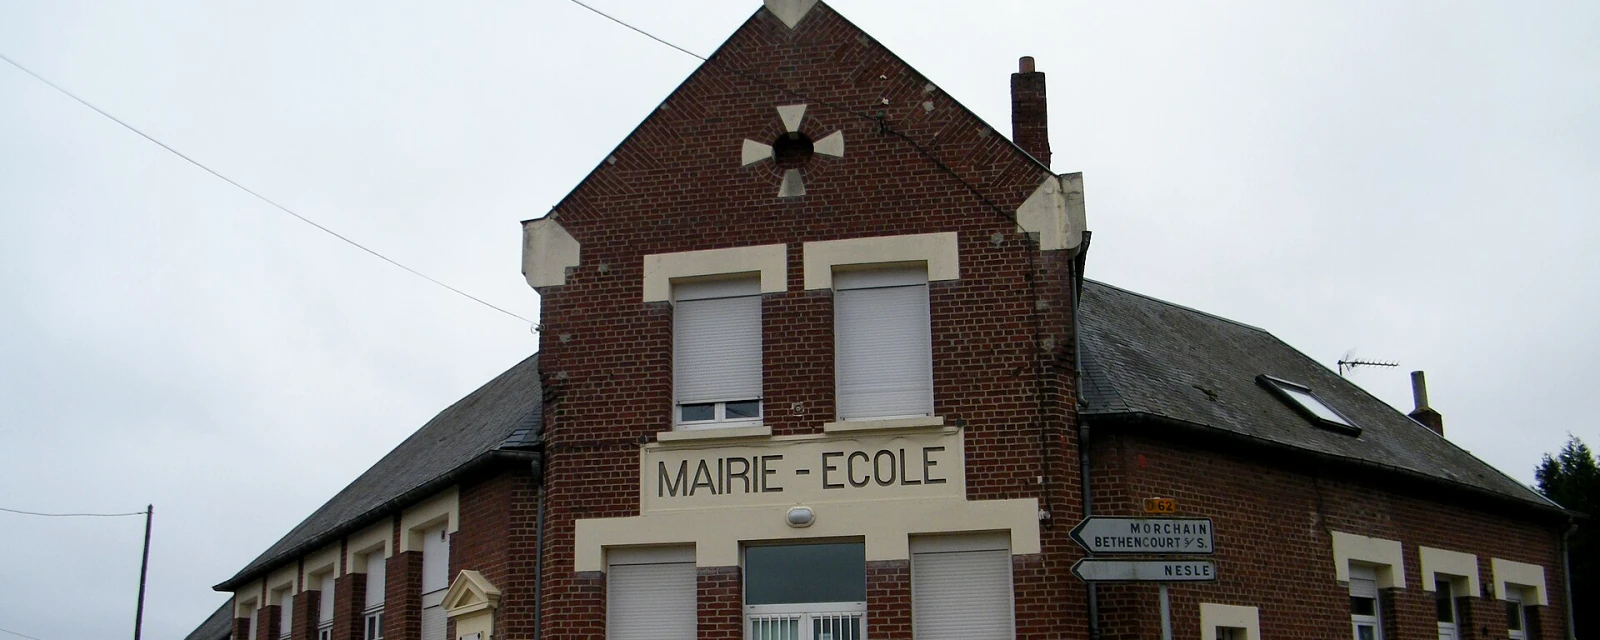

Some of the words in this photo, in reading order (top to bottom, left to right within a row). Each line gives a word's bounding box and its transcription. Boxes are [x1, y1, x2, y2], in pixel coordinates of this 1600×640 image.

[658, 454, 784, 498] MAIRIE
[822, 445, 948, 490] ECOLE
[1157, 500, 1174, 511] 62
[1130, 522, 1208, 535] MORCHAIN
[1094, 536, 1181, 548] BETHENCOURT
[1164, 565, 1210, 577] NESLE
